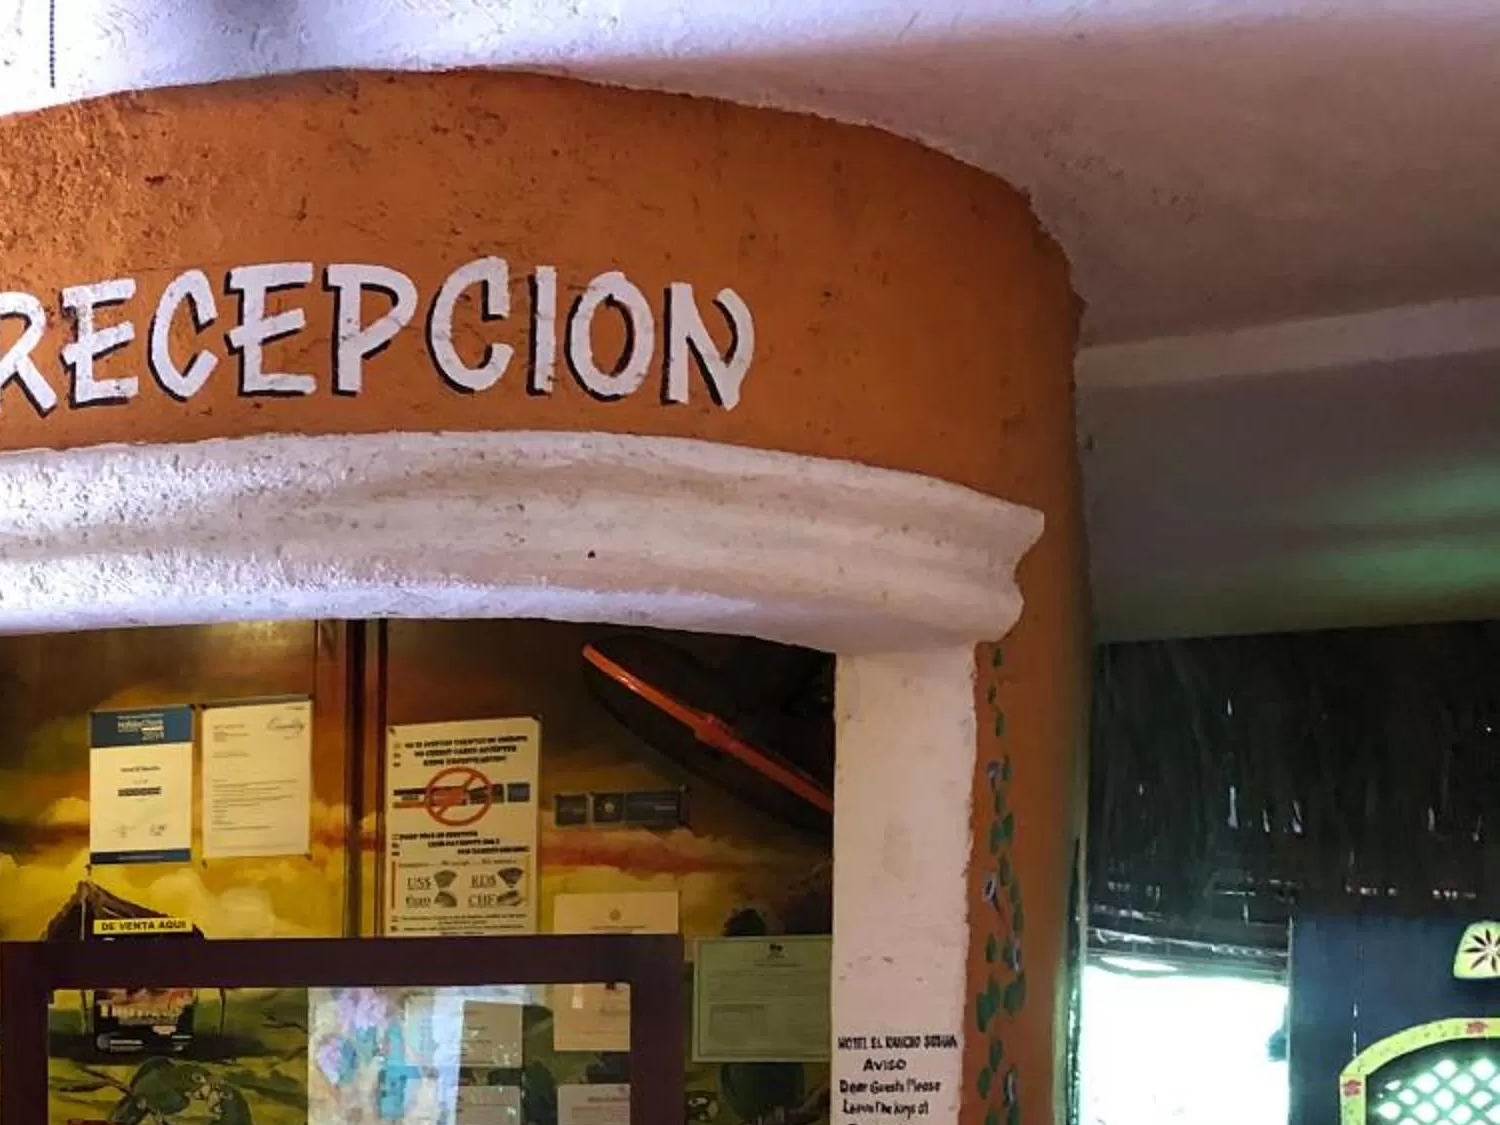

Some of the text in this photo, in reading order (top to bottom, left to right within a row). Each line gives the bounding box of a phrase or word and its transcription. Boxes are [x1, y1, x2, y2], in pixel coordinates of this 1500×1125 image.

[102, 919, 187, 931] DE VENTA AQUI
